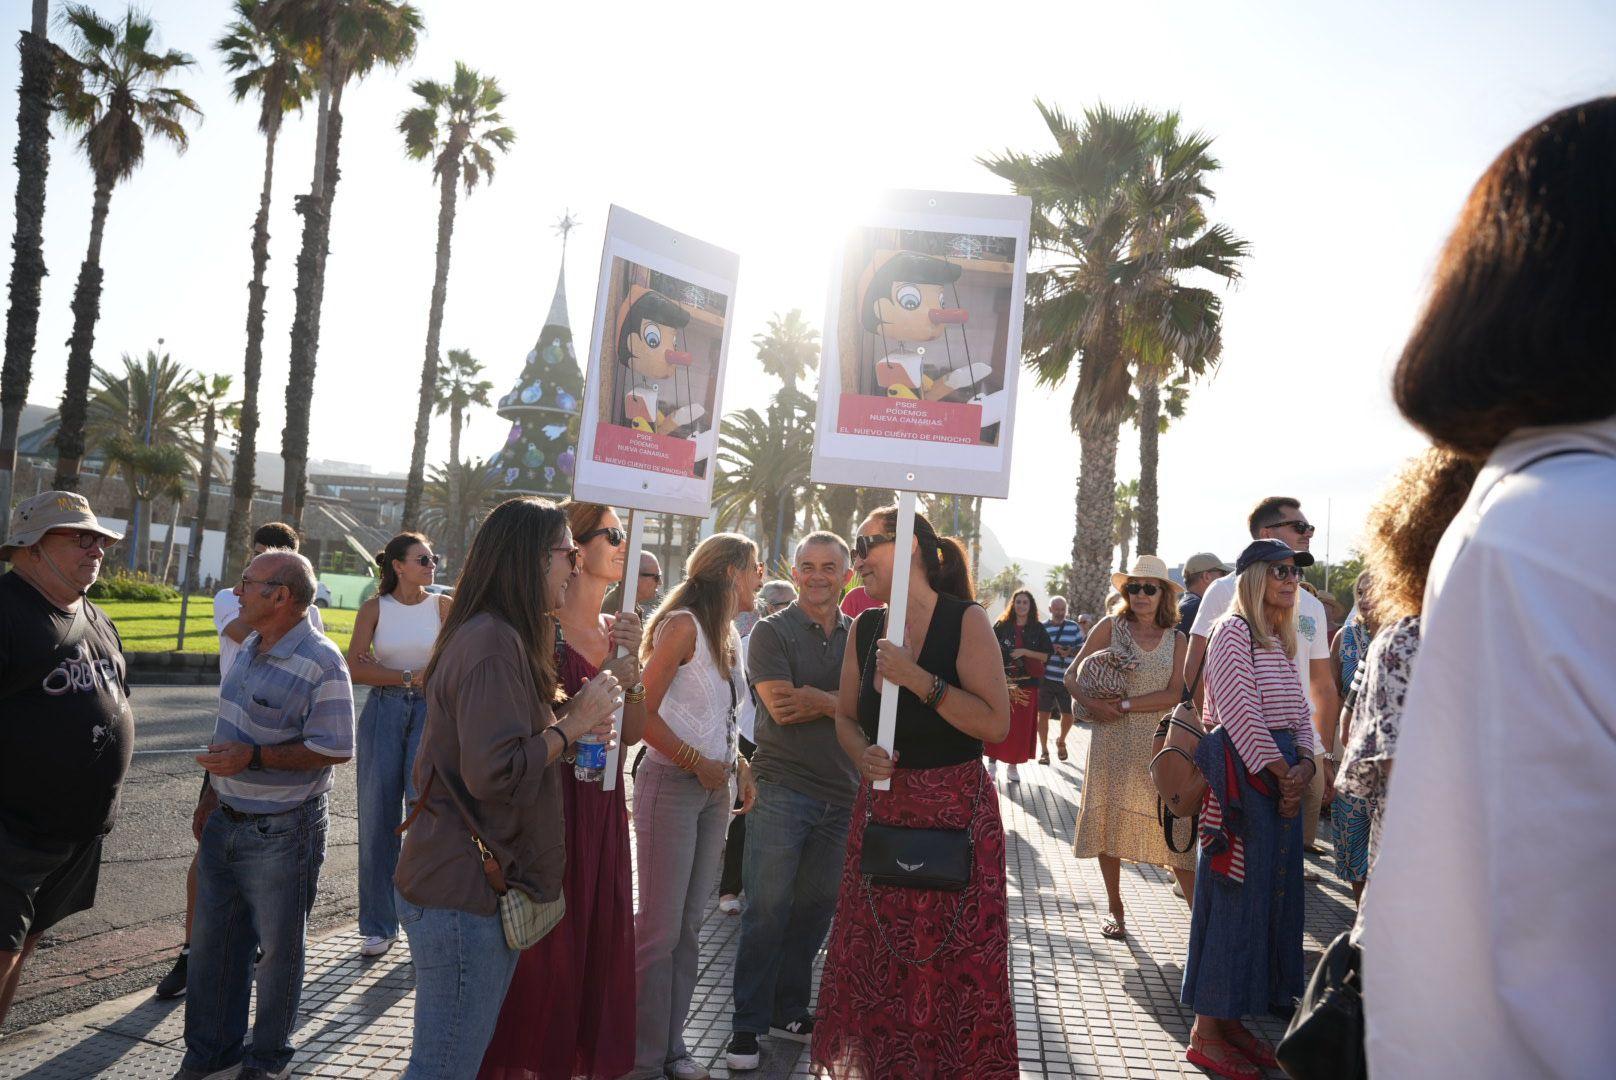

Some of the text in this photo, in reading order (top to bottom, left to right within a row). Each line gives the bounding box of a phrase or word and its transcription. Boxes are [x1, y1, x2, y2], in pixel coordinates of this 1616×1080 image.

[895, 400, 918, 409] PSOE
[885, 408, 928, 418] PODEMOS
[869, 414, 944, 426] NUEVA CANARIAS
[636, 432, 653, 441] PSOE
[839, 426, 972, 444] EL NUEVO CUENTO DE PINOCHO
[629, 438, 659, 450] PODEMOS
[617, 444, 670, 460] NUEVA CANARIAS
[605, 456, 627, 466] NUEVO
[627, 460, 652, 470] CUENTO
[652, 464, 660, 472] DE
